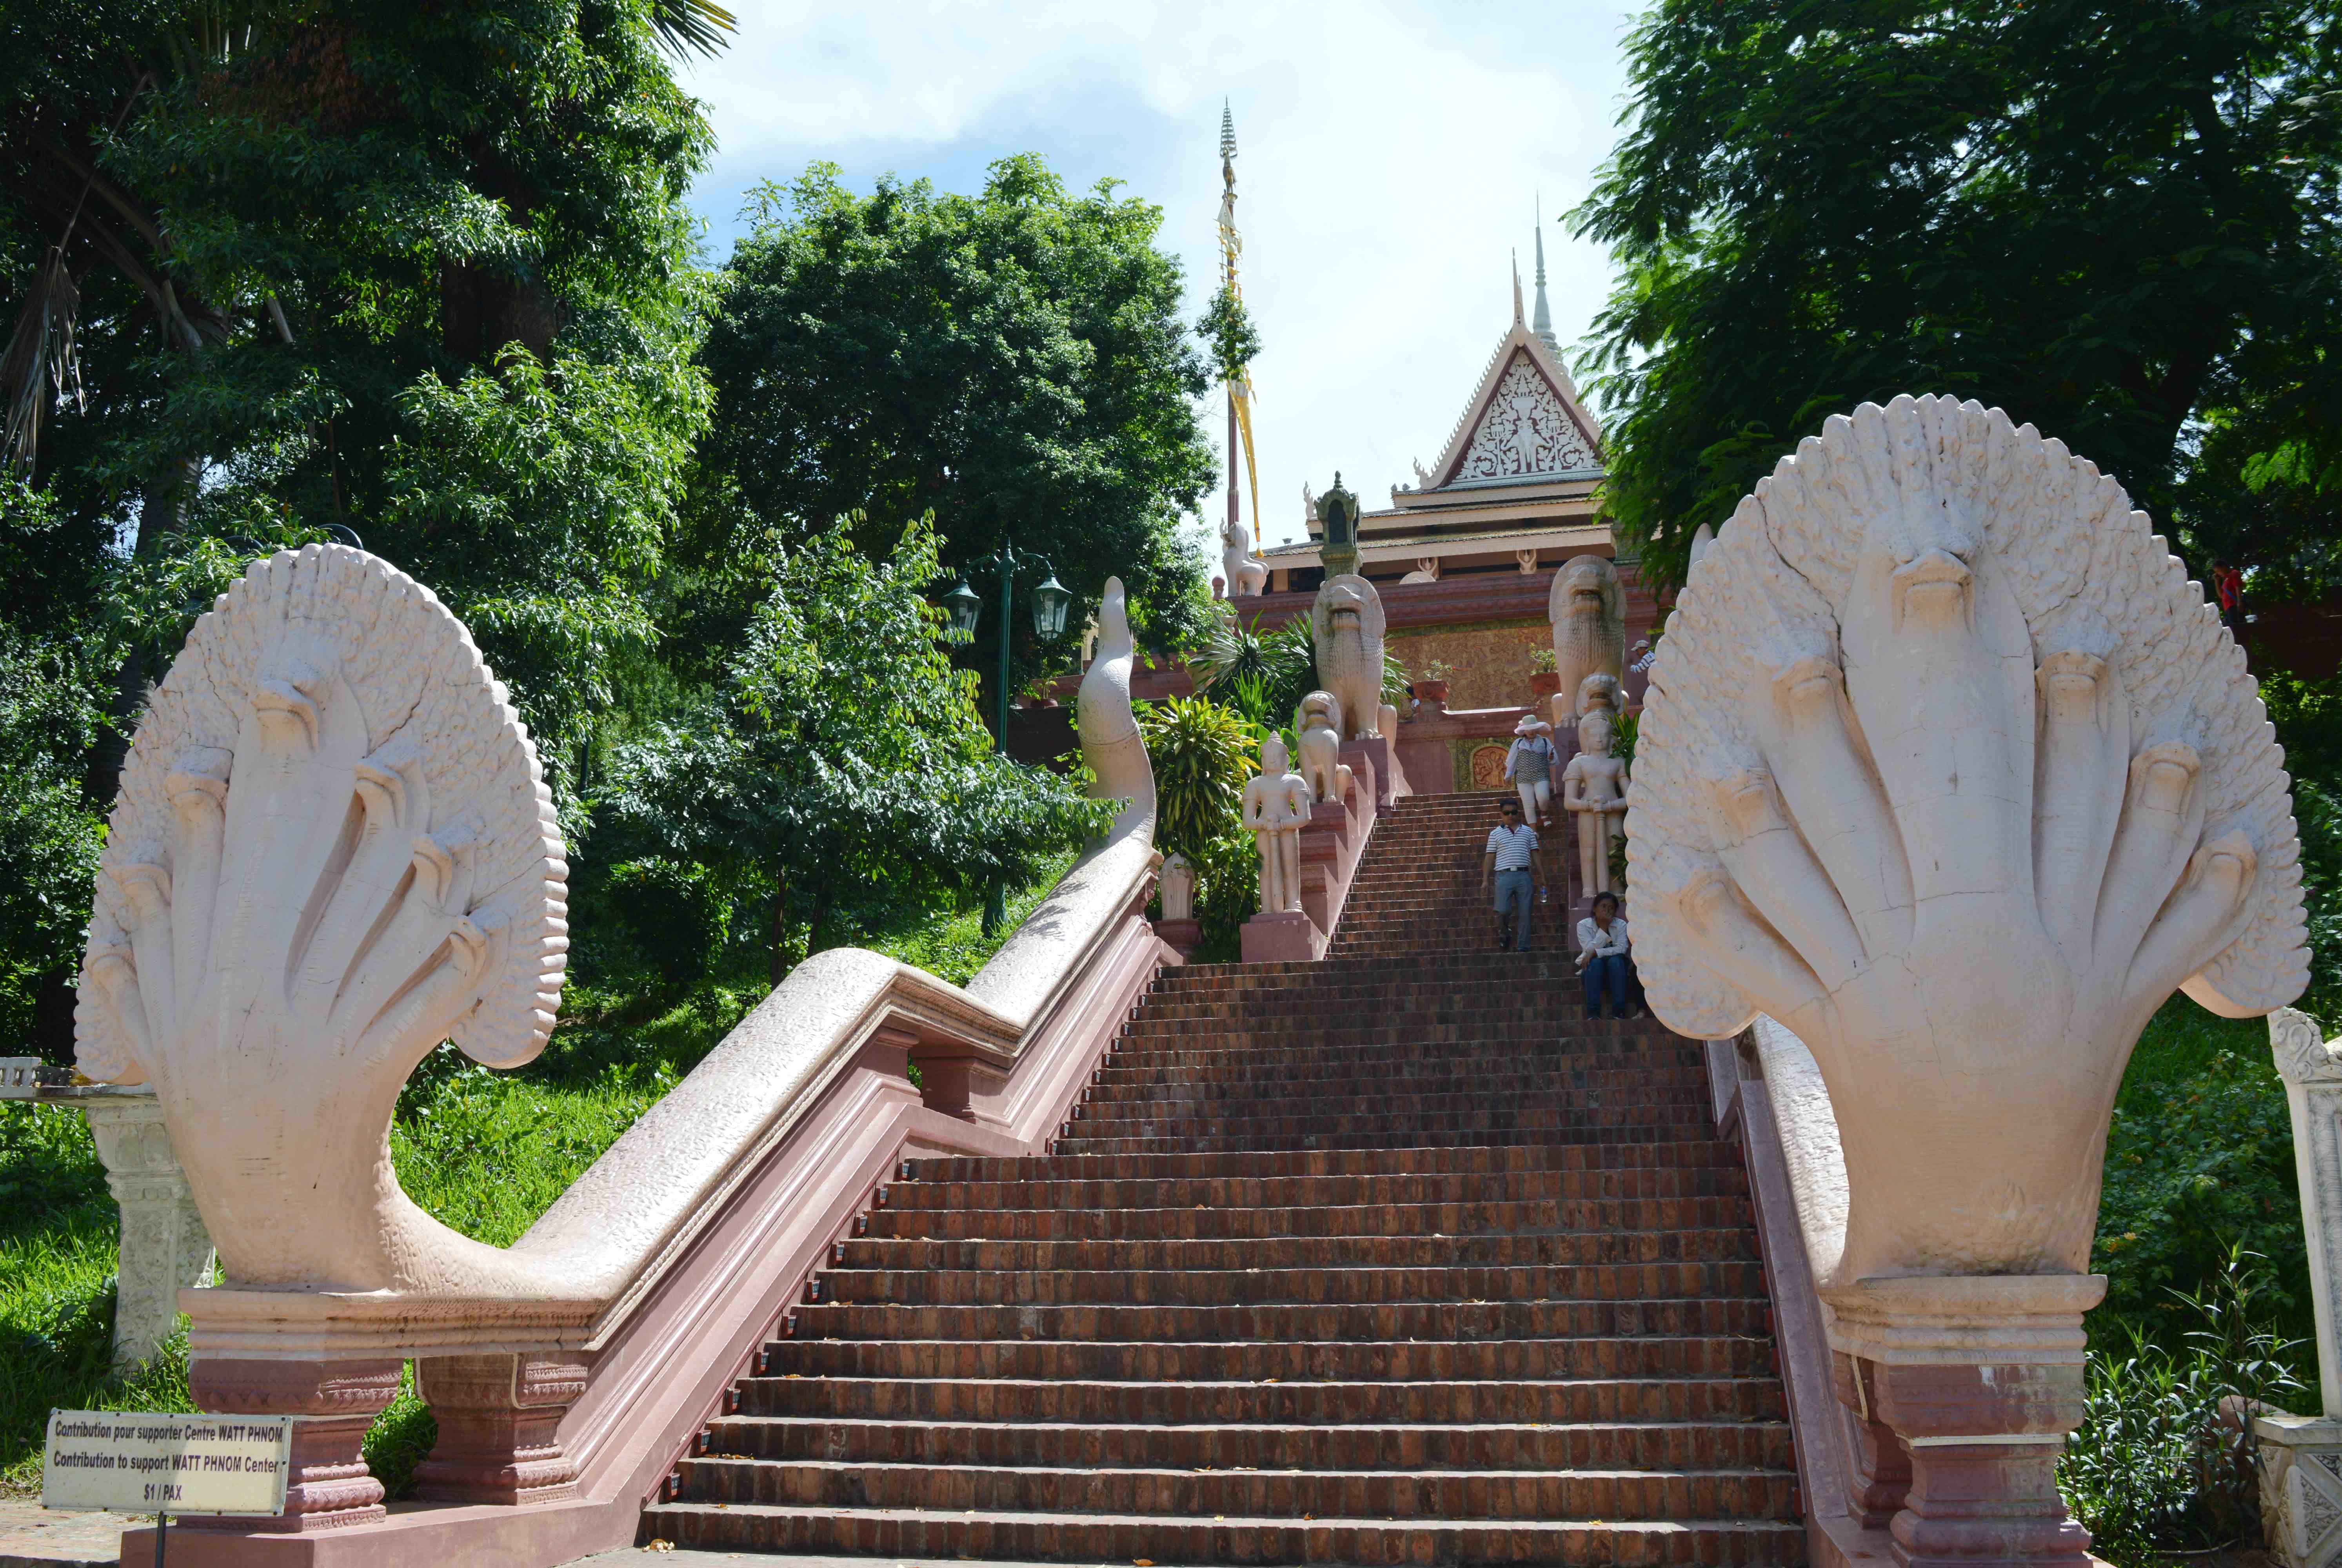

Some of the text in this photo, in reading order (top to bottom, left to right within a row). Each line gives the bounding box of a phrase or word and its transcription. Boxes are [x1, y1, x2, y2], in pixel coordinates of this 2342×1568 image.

[56, 1420, 283, 1443] Contribution pour supporter Centre WATT PHNOM
[54, 1451, 279, 1473] Contribution to support WATT PHNOM Center
[144, 1483, 182, 1501] $1 / PAX
